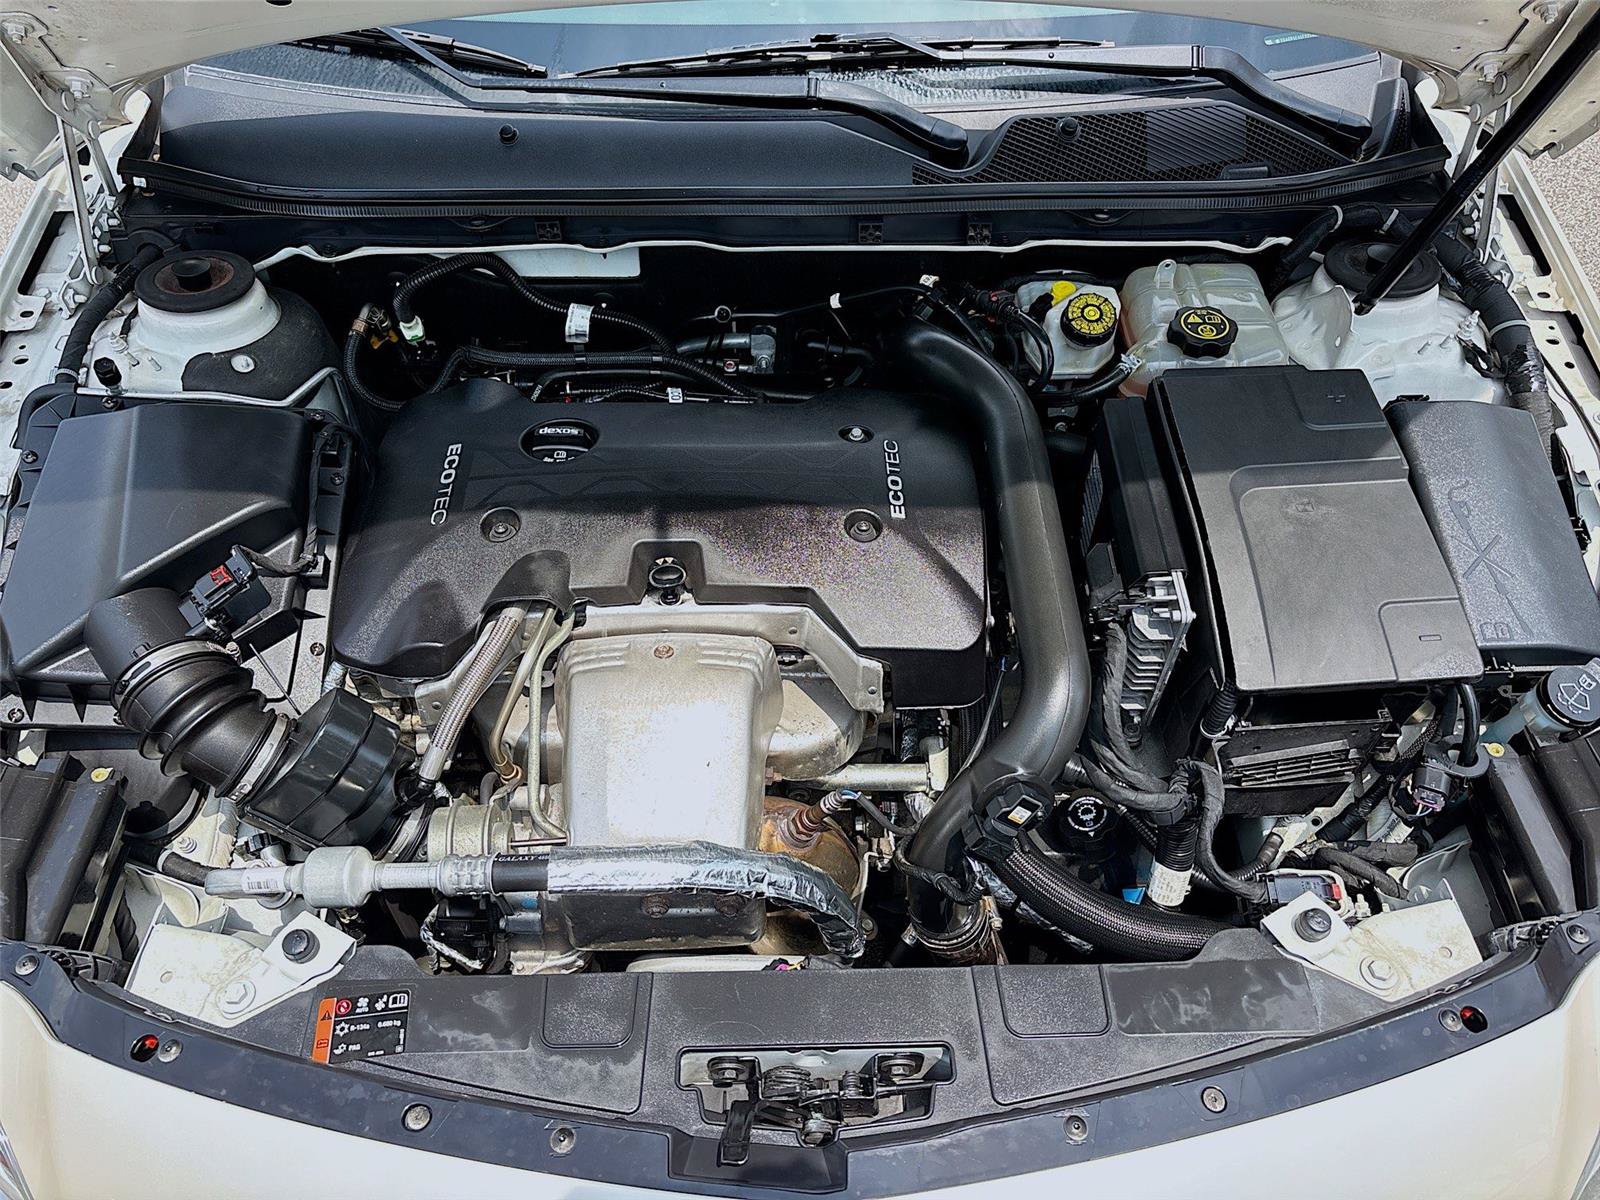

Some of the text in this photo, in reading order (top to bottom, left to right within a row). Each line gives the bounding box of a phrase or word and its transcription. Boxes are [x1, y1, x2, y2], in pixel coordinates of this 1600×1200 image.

[539, 426, 579, 435] dexos
[430, 443, 462, 526] ECOTEC
[883, 439, 906, 519] ECOTEC
